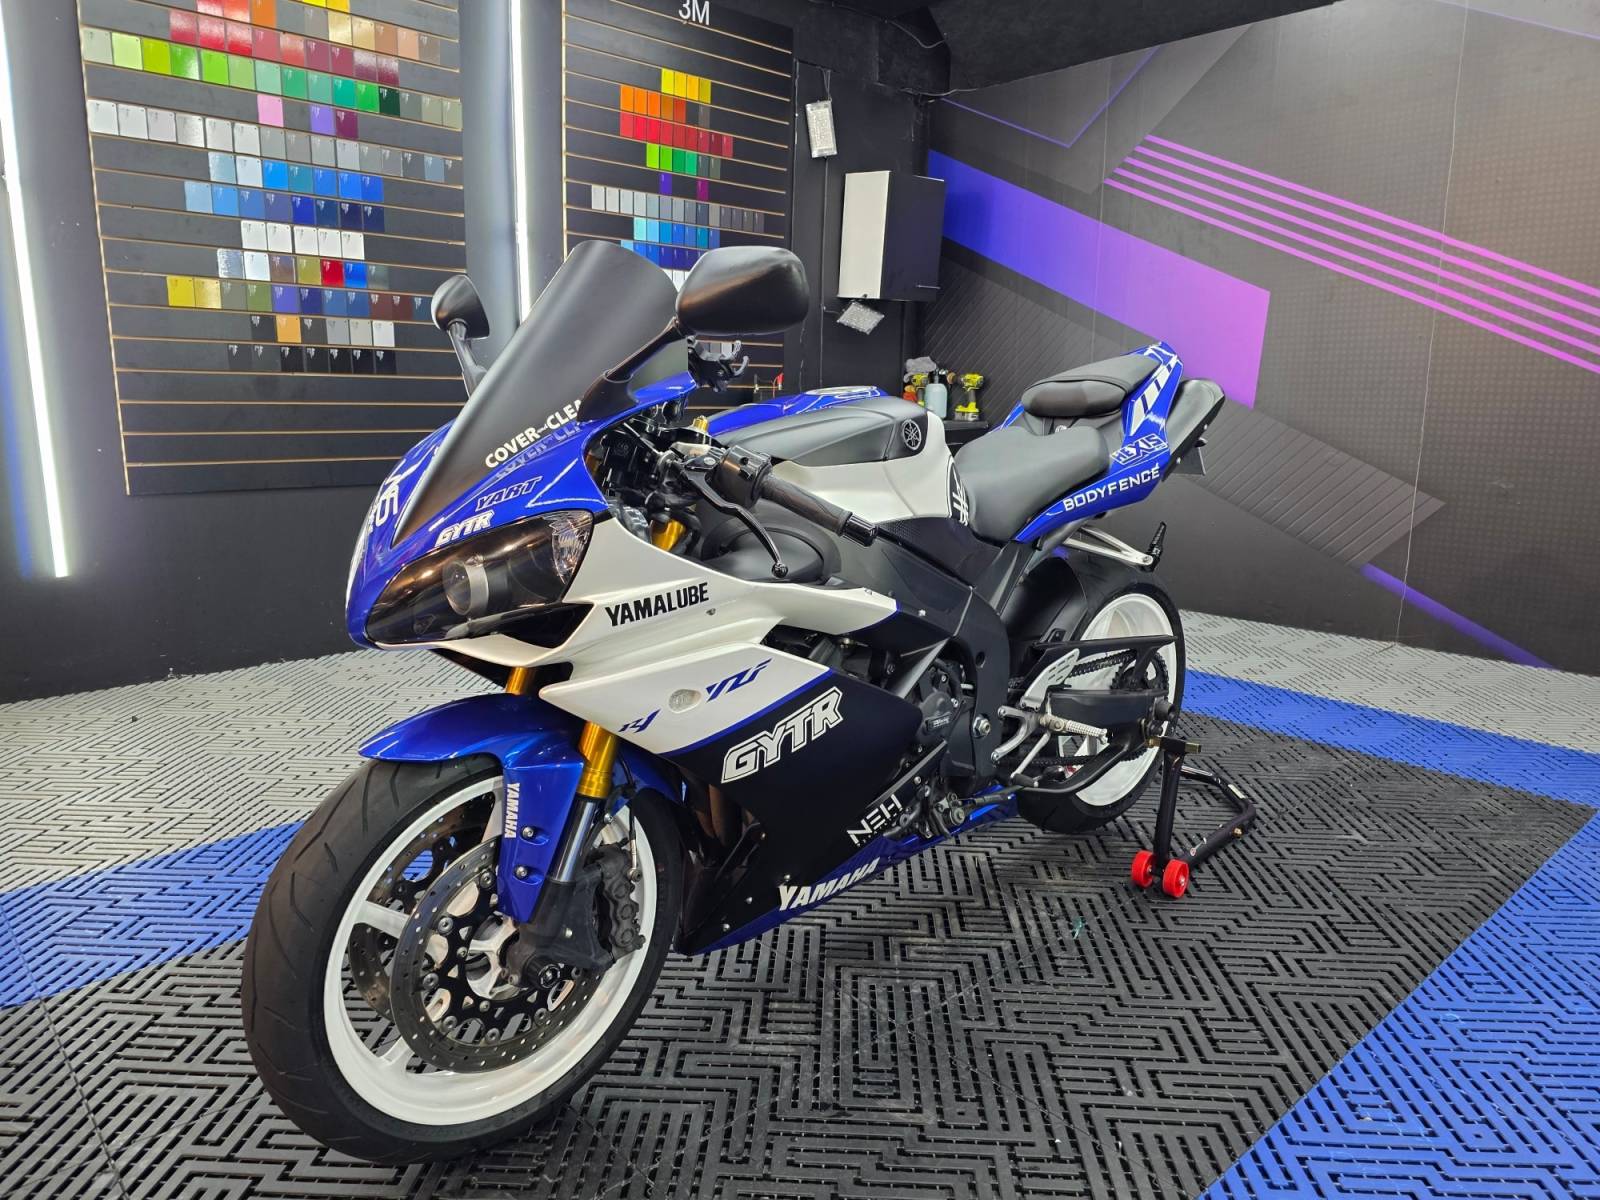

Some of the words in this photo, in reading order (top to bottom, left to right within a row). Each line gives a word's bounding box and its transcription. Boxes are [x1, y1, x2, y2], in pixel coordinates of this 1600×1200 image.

[678, 0, 710, 26] 3M
[1111, 432, 1167, 466] HEXIS
[434, 510, 495, 548] GYTR
[604, 582, 710, 628] YAMALUBE
[720, 686, 844, 785] GYTR
[504, 781, 521, 840] YAMAHA
[777, 857, 881, 912] YAMAHA
